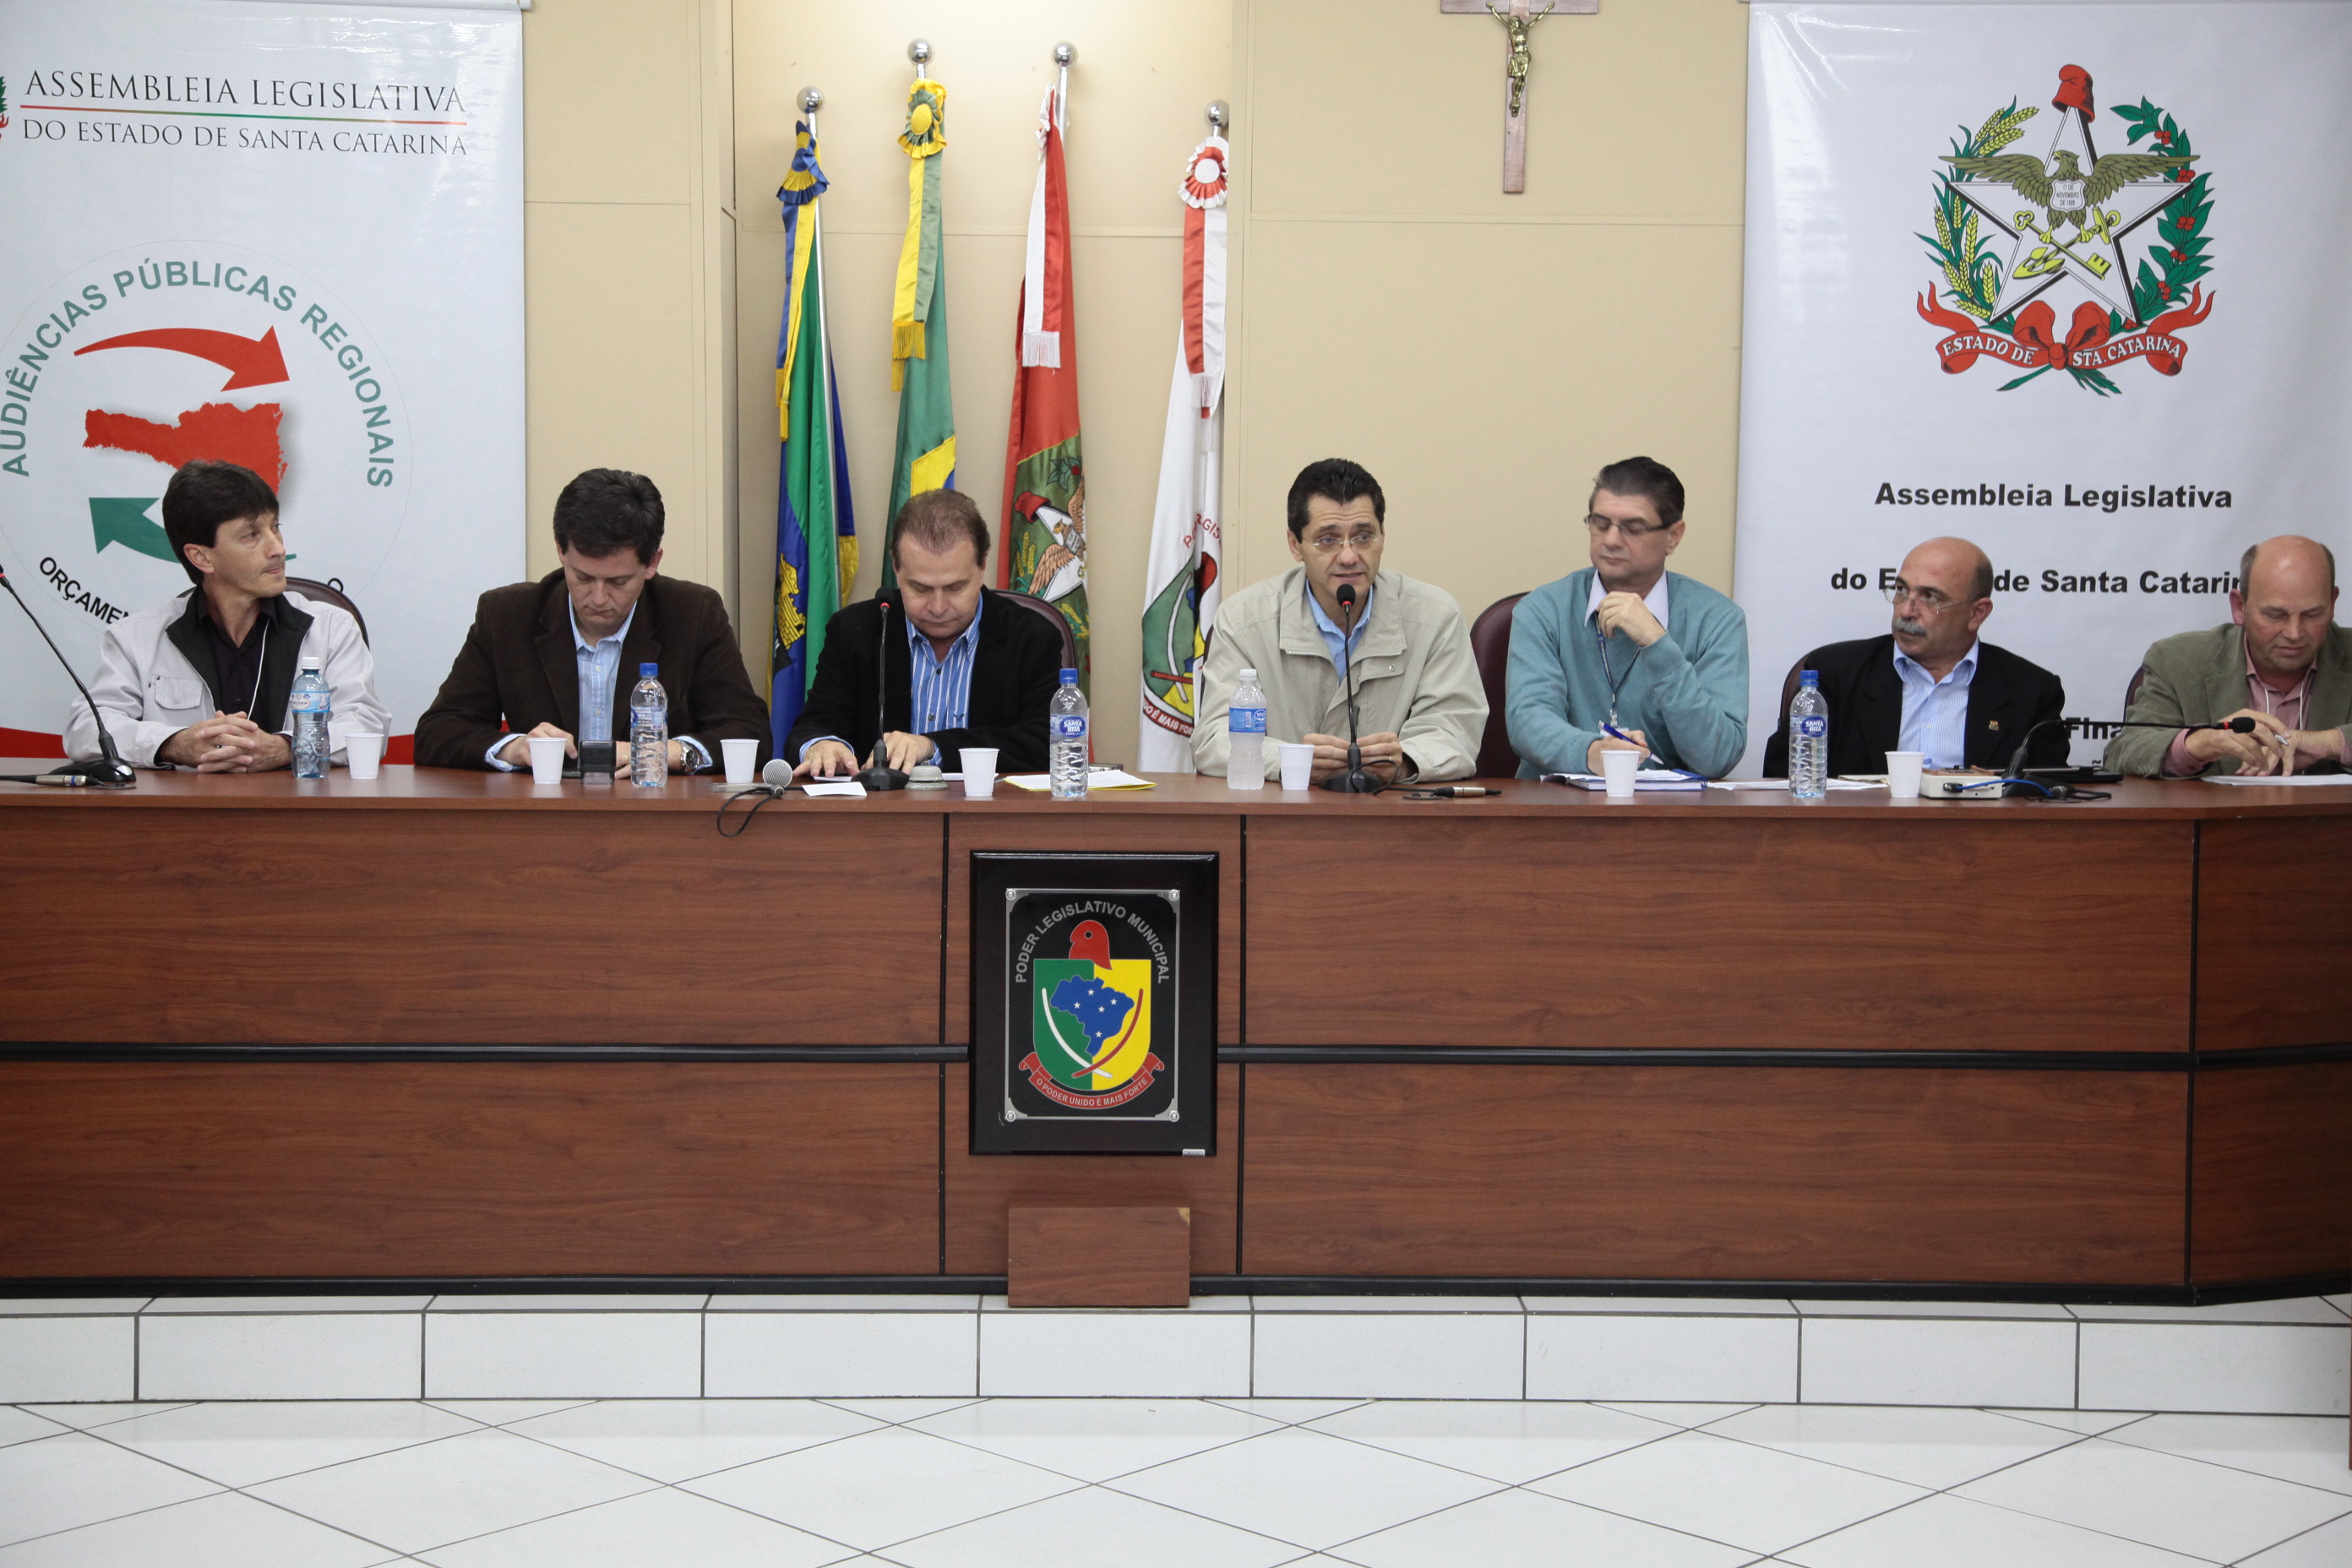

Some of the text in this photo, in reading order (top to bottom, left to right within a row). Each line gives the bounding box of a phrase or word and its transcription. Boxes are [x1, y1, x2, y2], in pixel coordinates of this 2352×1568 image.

[24, 70, 467, 112] ASSEMBLEIA LEGISLATIVA
[23, 118, 468, 155] DO ESTADO DE SANTA CATARINA
[1942, 335, 2034, 365] ESTADO DE
[2072, 337, 2181, 367] STA. CATARINA
[0, 257, 395, 488] AUDIÊNCIAS PÚBLICAS REGIONAIS
[1874, 482, 2233, 514] Assembleia Legislativa
[40, 557, 129, 624] ORÇAME
[1831, 567, 1867, 590] do
[1993, 569, 2030, 593] de
[2040, 569, 2128, 593] Santa
[1157, 714, 1179, 730] MAIS
[1179, 724, 1194, 735] FOR
[1015, 901, 1170, 984] PODER LEGISLATIVO MUNICIPAL
[1042, 1083, 1069, 1102] PODER
[1070, 1097, 1095, 1107] UNIDO
[1103, 1096, 1123, 1105] MAIS
[1124, 1078, 1148, 1098] FORTE
